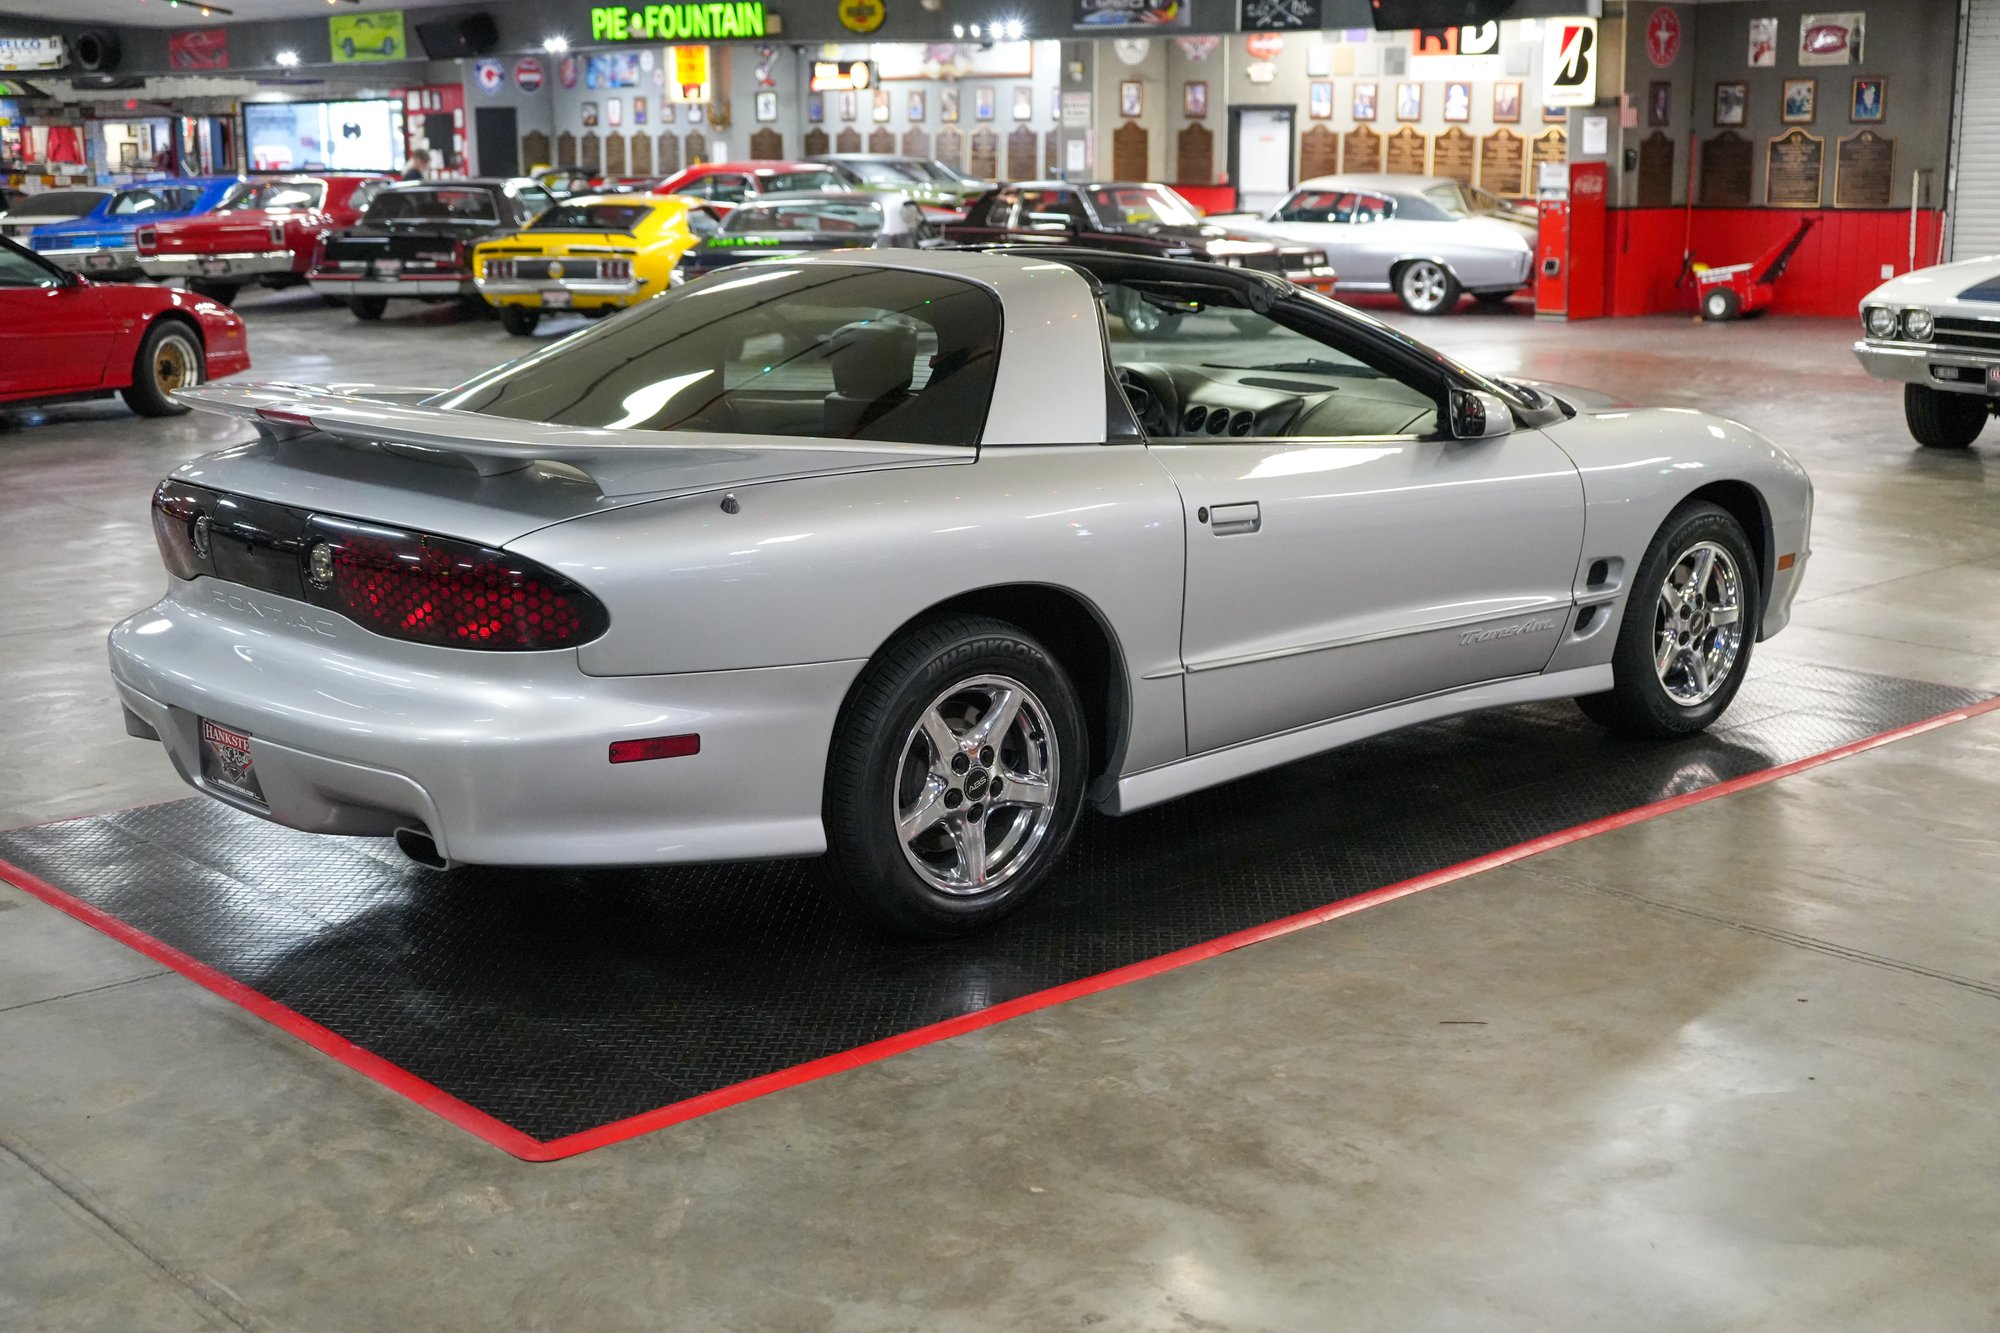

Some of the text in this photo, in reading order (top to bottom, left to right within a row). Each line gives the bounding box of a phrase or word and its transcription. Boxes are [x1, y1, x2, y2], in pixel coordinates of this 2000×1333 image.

[591, 2, 764, 40] PIE FOUNTAIN
[211, 589, 337, 638] PONTIAC
[968, 775, 987, 794] ABS
